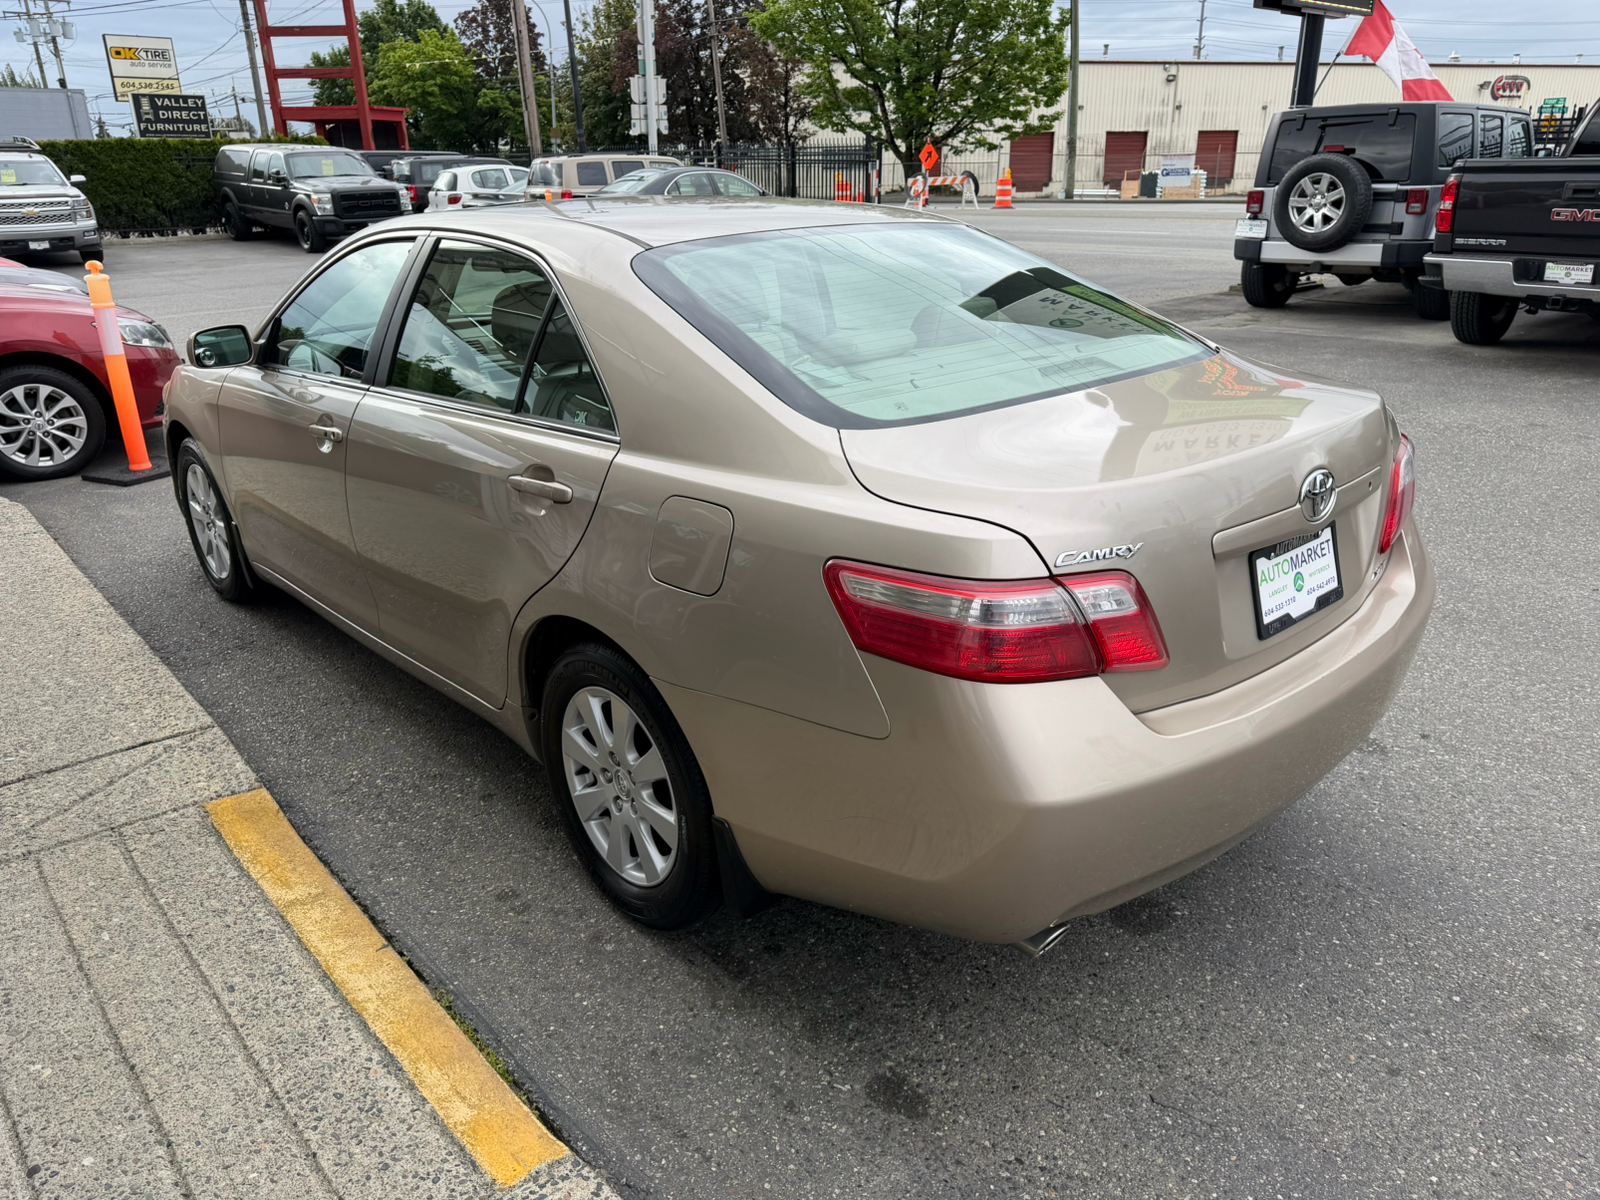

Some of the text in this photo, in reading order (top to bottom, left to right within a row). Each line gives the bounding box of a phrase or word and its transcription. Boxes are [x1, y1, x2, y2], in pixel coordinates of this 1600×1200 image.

[110, 47, 169, 60] OK TIRE
[120, 81, 175, 91] 604.530.2545
[154, 97, 203, 107] VALLEY
[159, 110, 206, 120] DIRECT
[140, 122, 209, 132] FURNITURE
[1455, 238, 1507, 246] SIERRA
[1546, 265, 1593, 273] AUTOMARKET
[1054, 541, 1145, 568] CAMRY
[1259, 538, 1331, 587] AUTOMARKET
[1308, 563, 1331, 578] WHITEROCK
[1268, 584, 1288, 599] LANGLEY
[1264, 595, 1296, 618] 604-533-1310
